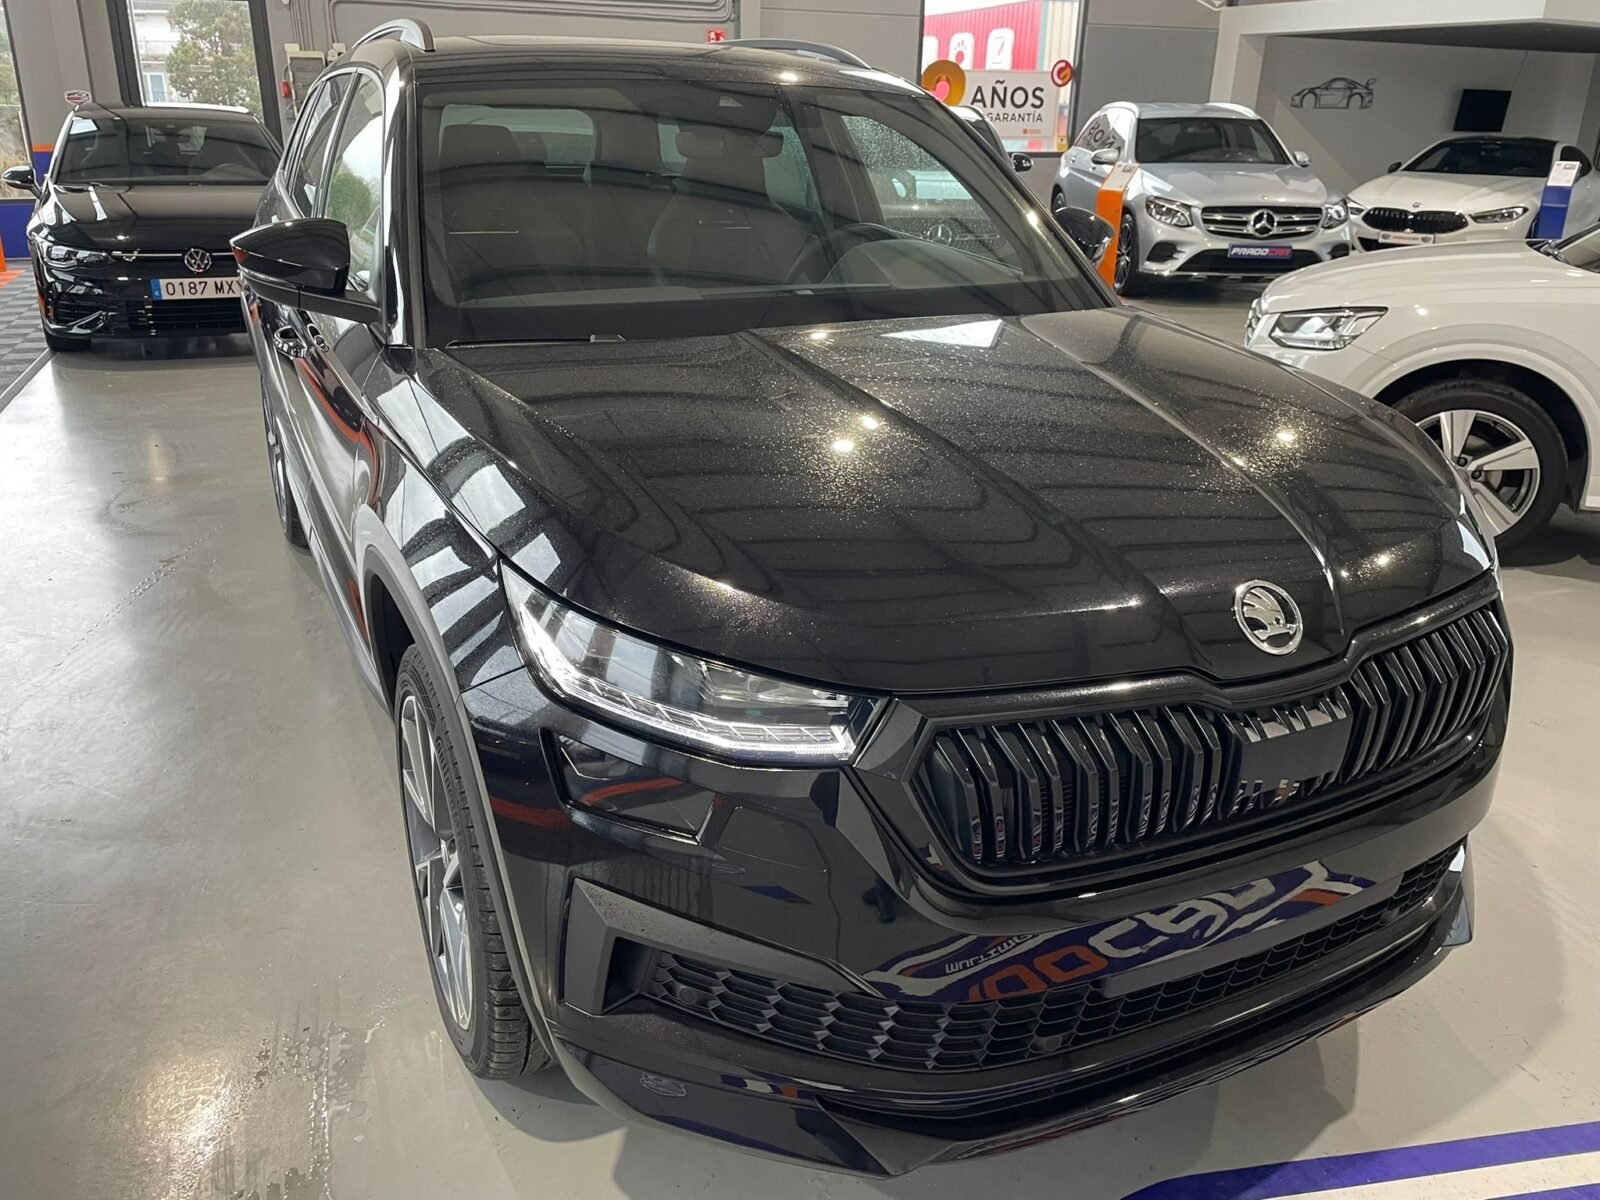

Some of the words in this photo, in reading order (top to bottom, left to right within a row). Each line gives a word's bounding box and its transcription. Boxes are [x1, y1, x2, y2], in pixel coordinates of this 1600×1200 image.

[970, 79, 1045, 109] AÑOS
[986, 110, 1043, 123] GARANTÍA
[165, 281, 208, 296] 0187
